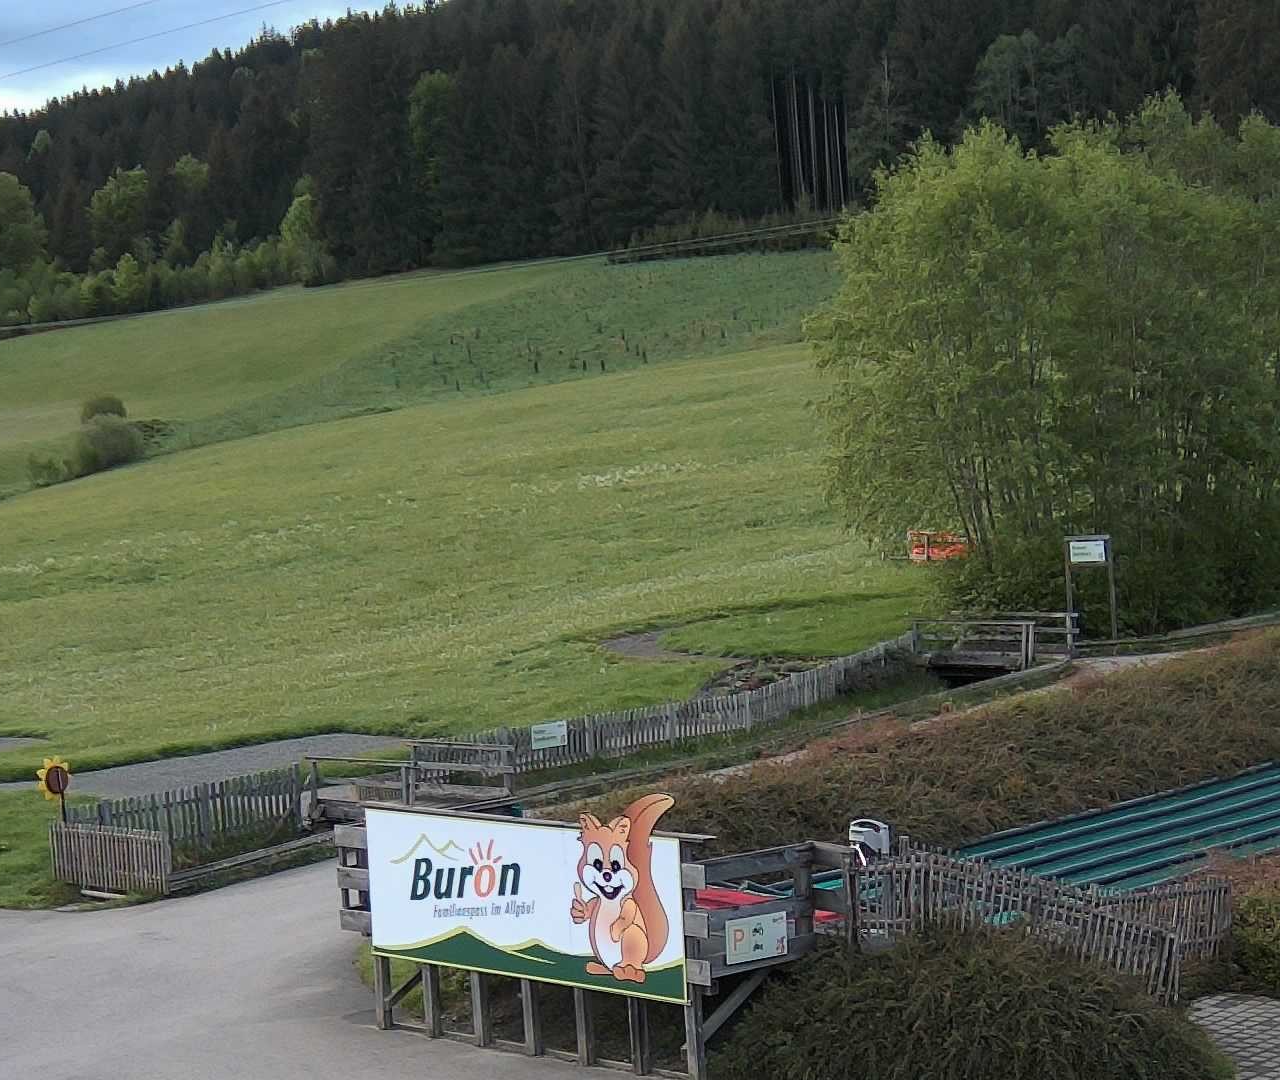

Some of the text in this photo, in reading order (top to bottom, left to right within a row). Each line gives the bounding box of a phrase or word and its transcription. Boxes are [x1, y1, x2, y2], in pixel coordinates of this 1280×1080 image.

[410, 857, 521, 901] Buron
[491, 903, 502, 915] im
[734, 929, 745, 951] P
